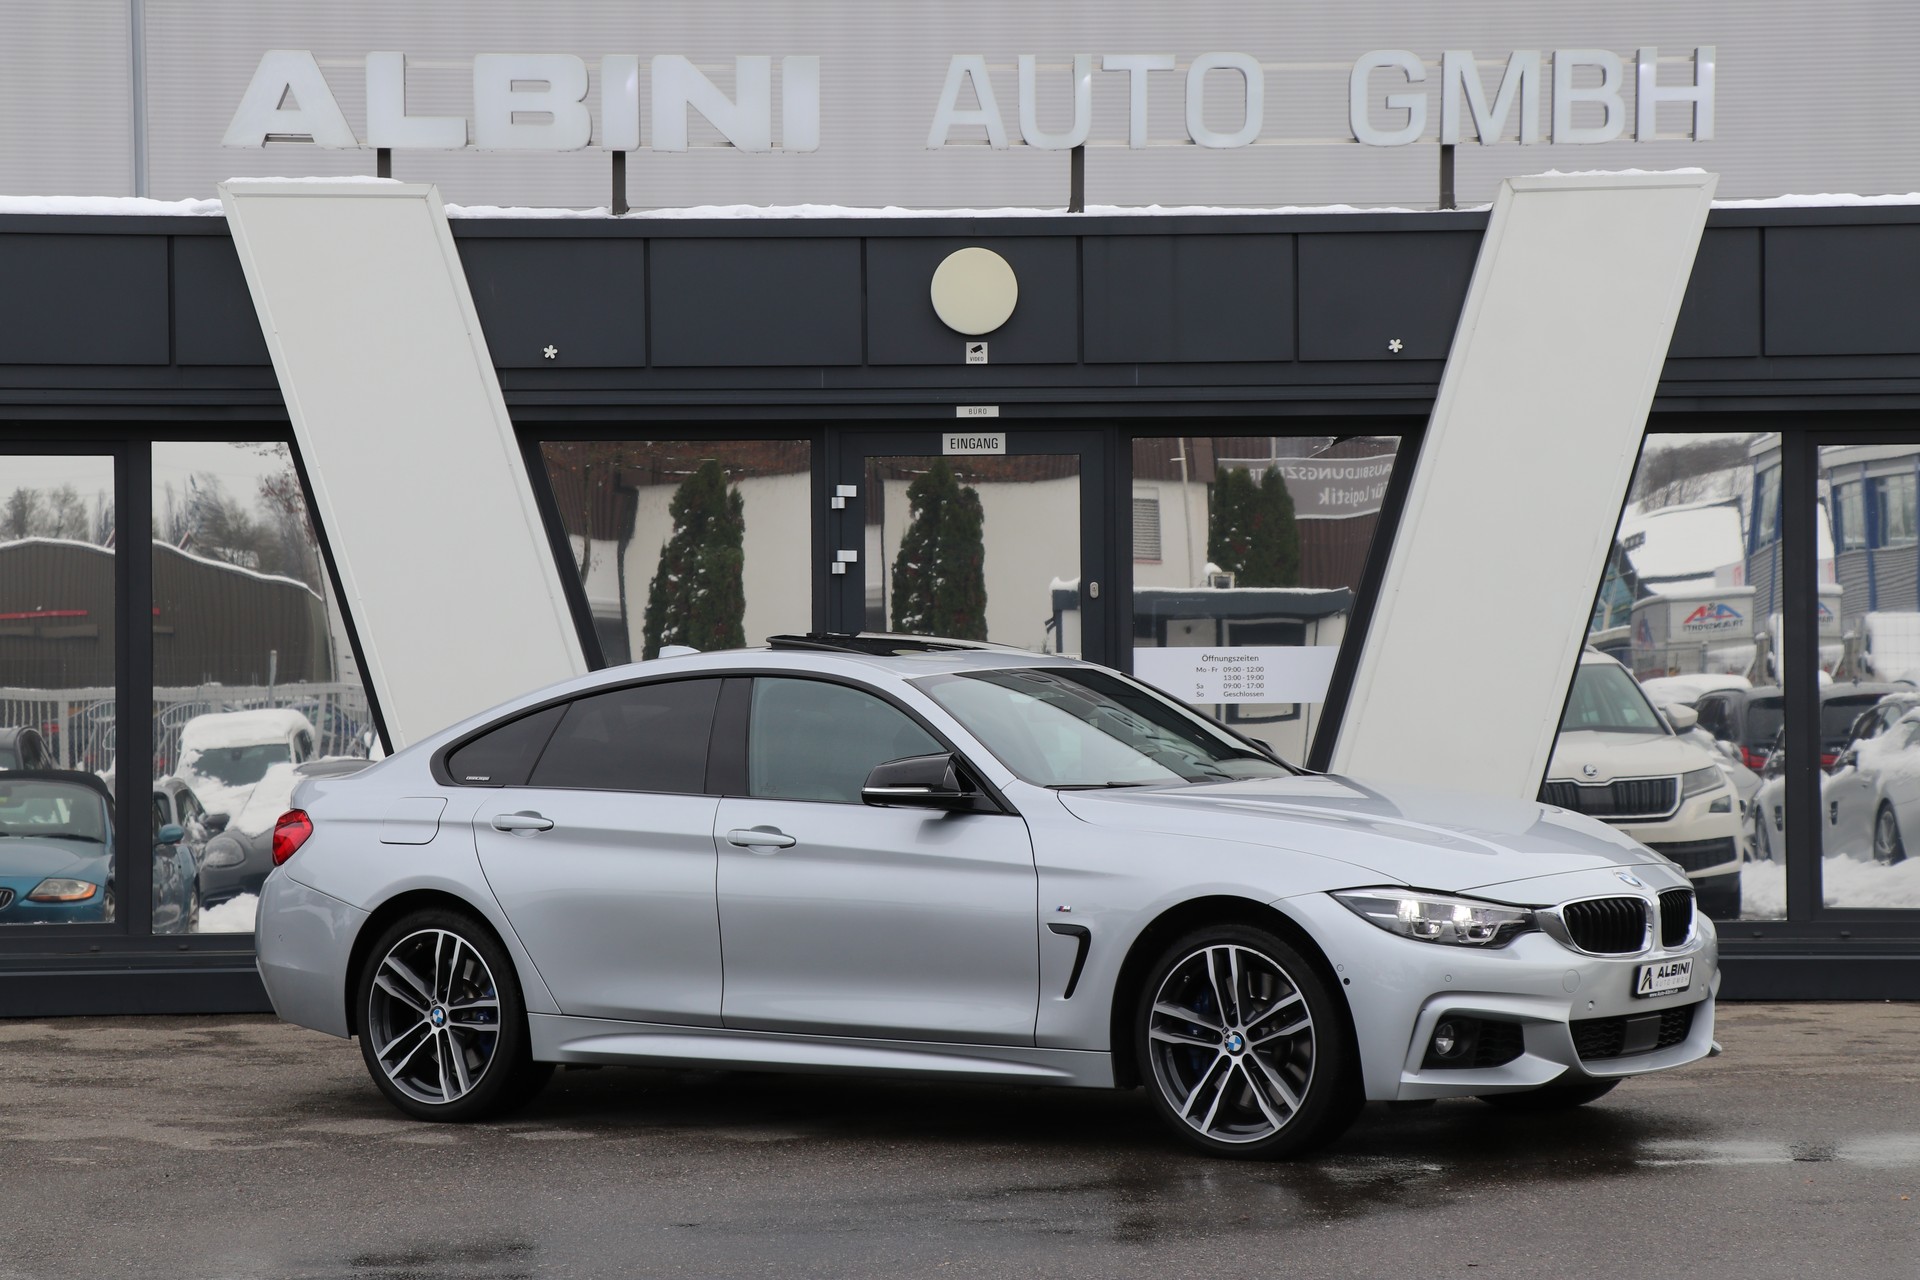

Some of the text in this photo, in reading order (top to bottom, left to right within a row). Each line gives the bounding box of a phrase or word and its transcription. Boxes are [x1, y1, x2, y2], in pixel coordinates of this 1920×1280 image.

[222, 46, 1716, 153] ALBINI AUTO GMBH
[968, 407, 988, 415] BÜRO
[950, 437, 999, 450] EINGANG
[1201, 654, 1260, 663] Öffnungszeiten
[1657, 961, 1690, 979] ALBINI
